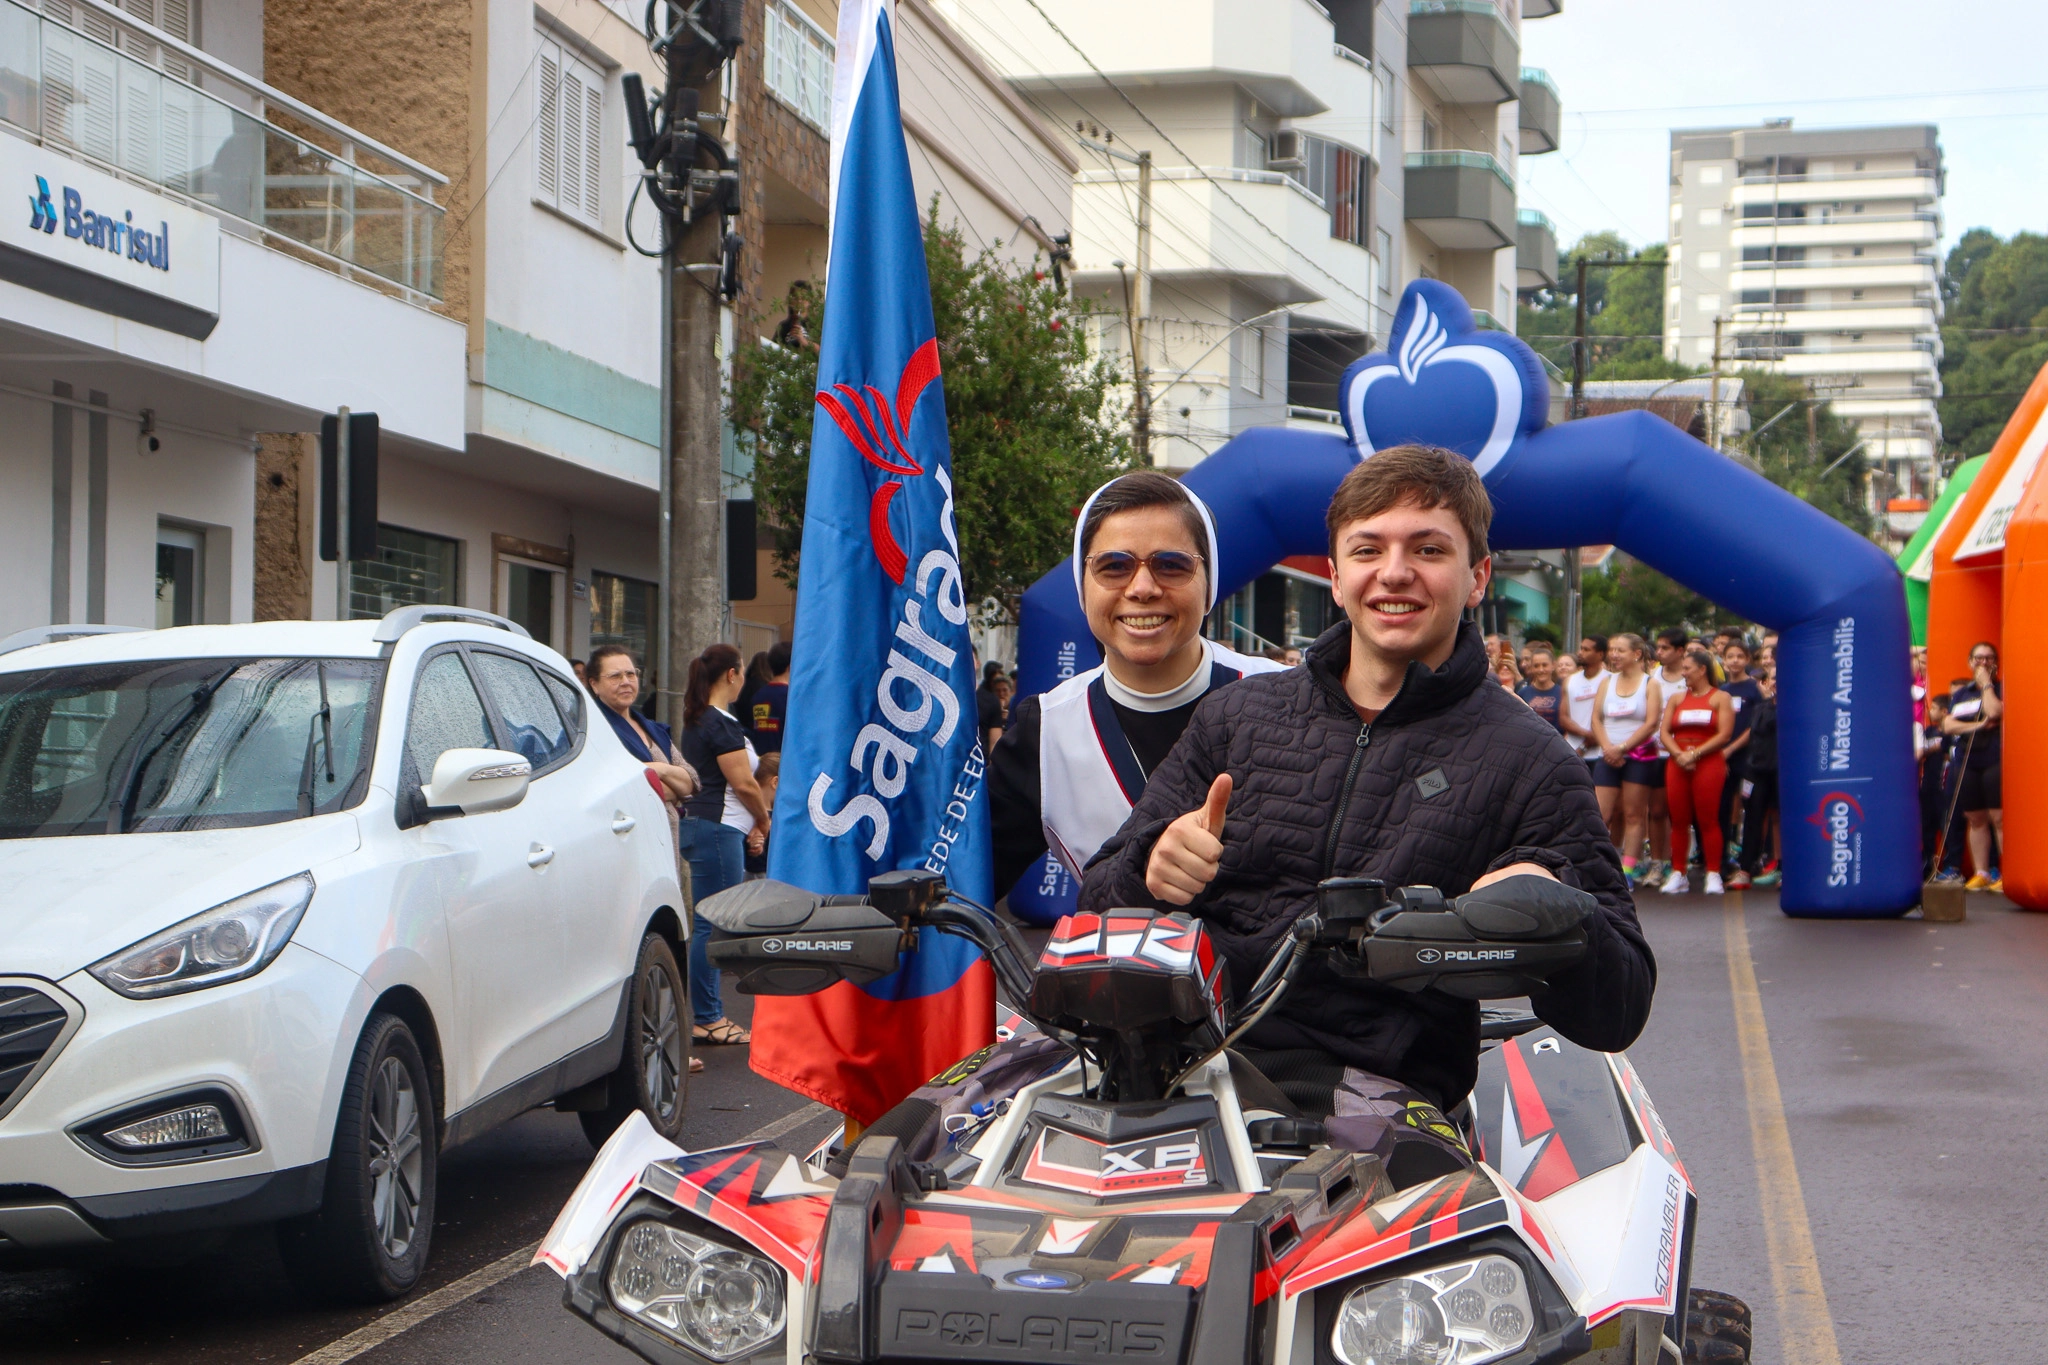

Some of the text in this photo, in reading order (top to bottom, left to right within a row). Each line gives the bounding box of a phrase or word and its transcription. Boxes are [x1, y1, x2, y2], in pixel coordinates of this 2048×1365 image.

[63, 185, 169, 272] Banrisul
[807, 463, 967, 862] Sagrad
[1057, 641, 1077, 680] bilis
[1830, 616, 1855, 770] Mater Amabilis
[924, 824, 959, 875] EDE
[945, 782, 977, 822] DE
[1827, 801, 1853, 887] Sagrado
[1038, 847, 1063, 897] Sagr
[785, 940, 852, 951] POLARIS
[1444, 949, 1516, 961] POLARIS
[1098, 1143, 1201, 1179] XP
[1654, 1173, 1681, 1304] SCRAMBLER
[894, 1307, 1166, 1358] POLARIS
